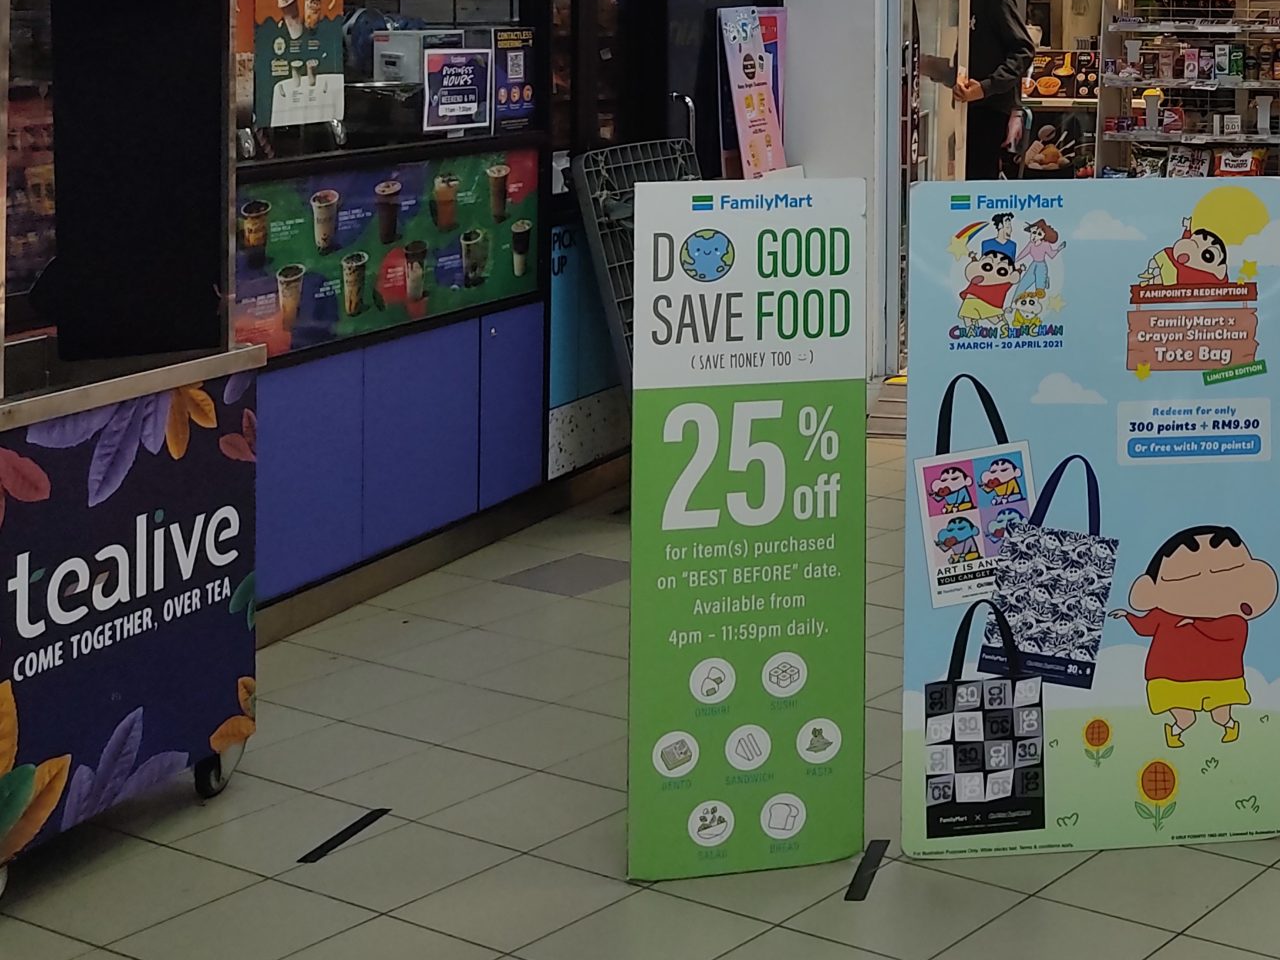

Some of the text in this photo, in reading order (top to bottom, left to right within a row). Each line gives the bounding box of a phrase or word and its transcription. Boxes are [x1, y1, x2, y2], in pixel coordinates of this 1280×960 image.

[497, 31, 533, 40] CONTACTLESS
[442, 66, 475, 76] BUSINESS
[443, 75, 475, 87] HOURS
[720, 194, 812, 210] FamilyMart
[977, 195, 1063, 211] FamilyMart
[757, 227, 850, 279] GOOD
[552, 256, 567, 276] UP
[1140, 287, 1248, 298] FAMIPOINTS REDEMPTION
[651, 289, 850, 346] SAVE FOOD
[1150, 316, 1226, 330] FamilyMart
[1137, 329, 1248, 343] Crayon ShinChan
[956, 339, 1063, 350] MARCH 20 APRIL 2021
[730, 351, 792, 369] MONEY TOO
[1154, 346, 1232, 364] Tote Bag
[1206, 364, 1263, 381] LIMITED EDITION
[1152, 405, 1237, 418] Redeem for only
[1129, 419, 1260, 434] 300 points RM9.90
[1135, 440, 1254, 453] Or free with 700 points!
[793, 473, 841, 520] off
[665, 534, 836, 561] for item(s) purchased
[8, 505, 240, 639] tealive
[657, 563, 841, 590] on date.
[937, 564, 974, 578] ART IS
[940, 570, 992, 585] YOU CAN GET
[693, 592, 806, 616] Available from
[13, 576, 232, 683] COME TOGETHER, OVER TEA
[668, 618, 829, 649] 4pm 11:59pm daily.
